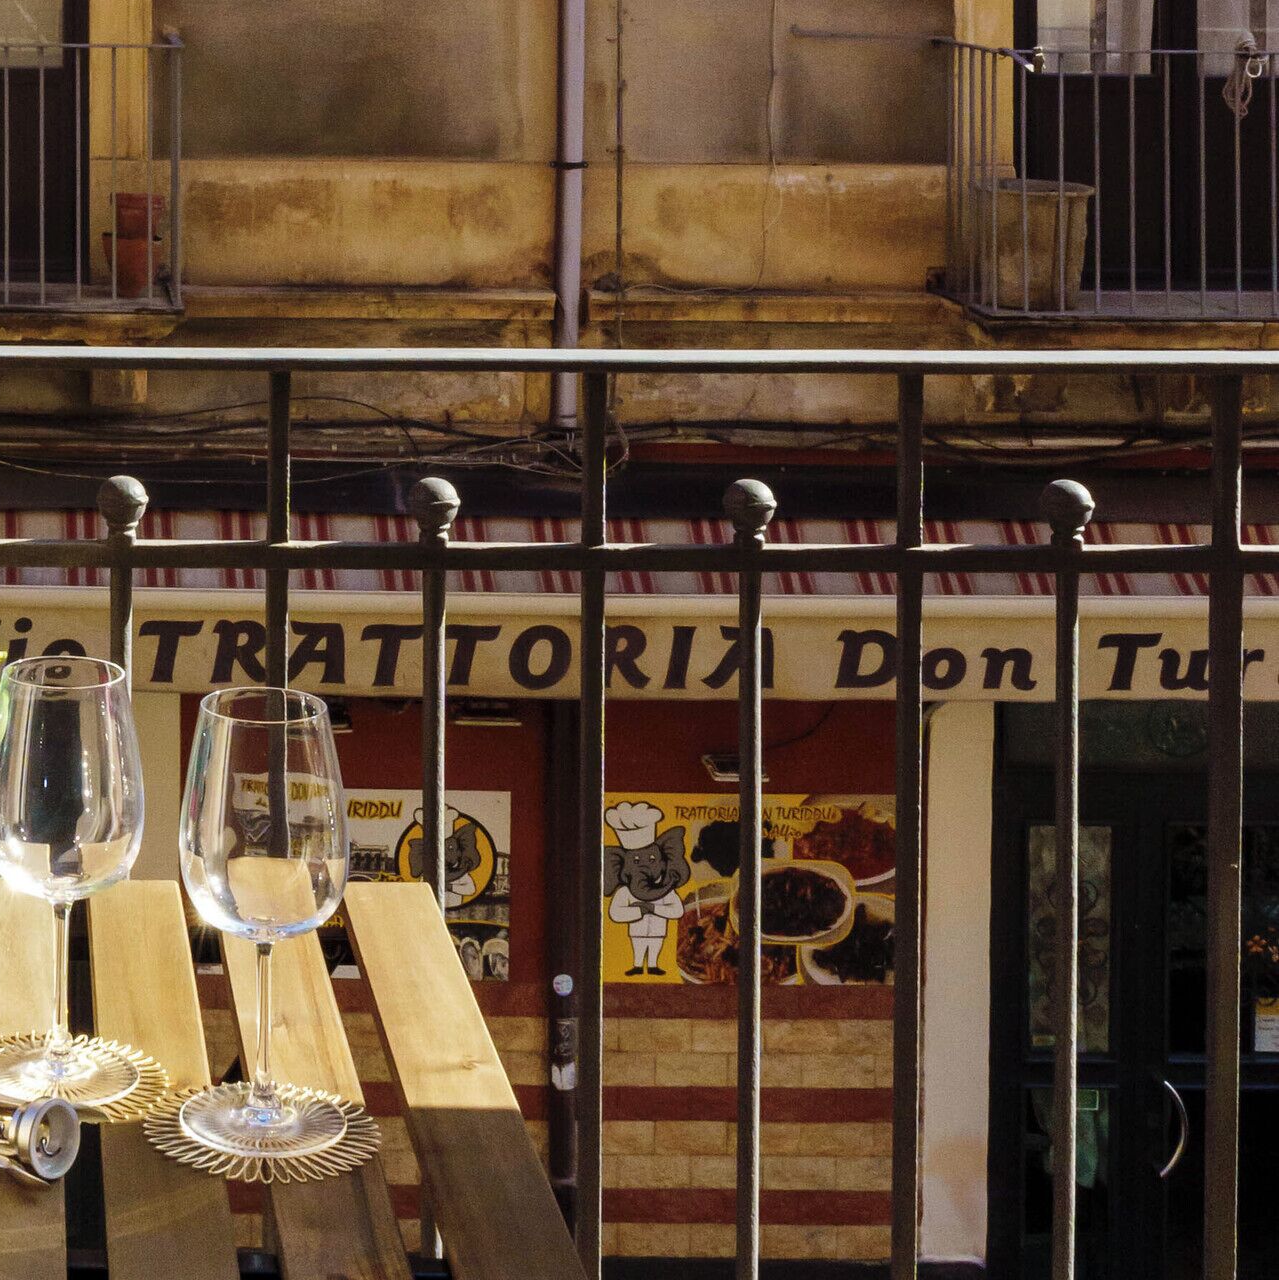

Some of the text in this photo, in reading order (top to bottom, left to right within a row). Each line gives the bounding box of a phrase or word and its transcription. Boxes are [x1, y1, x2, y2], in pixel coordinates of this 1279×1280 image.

[138, 620, 775, 690] TRATTORIA
[834, 629, 1038, 690] Don
[1097, 632, 1279, 691] Tur
[674, 806, 740, 821] TRATTORIA
[776, 806, 832, 821] TURIDDU
